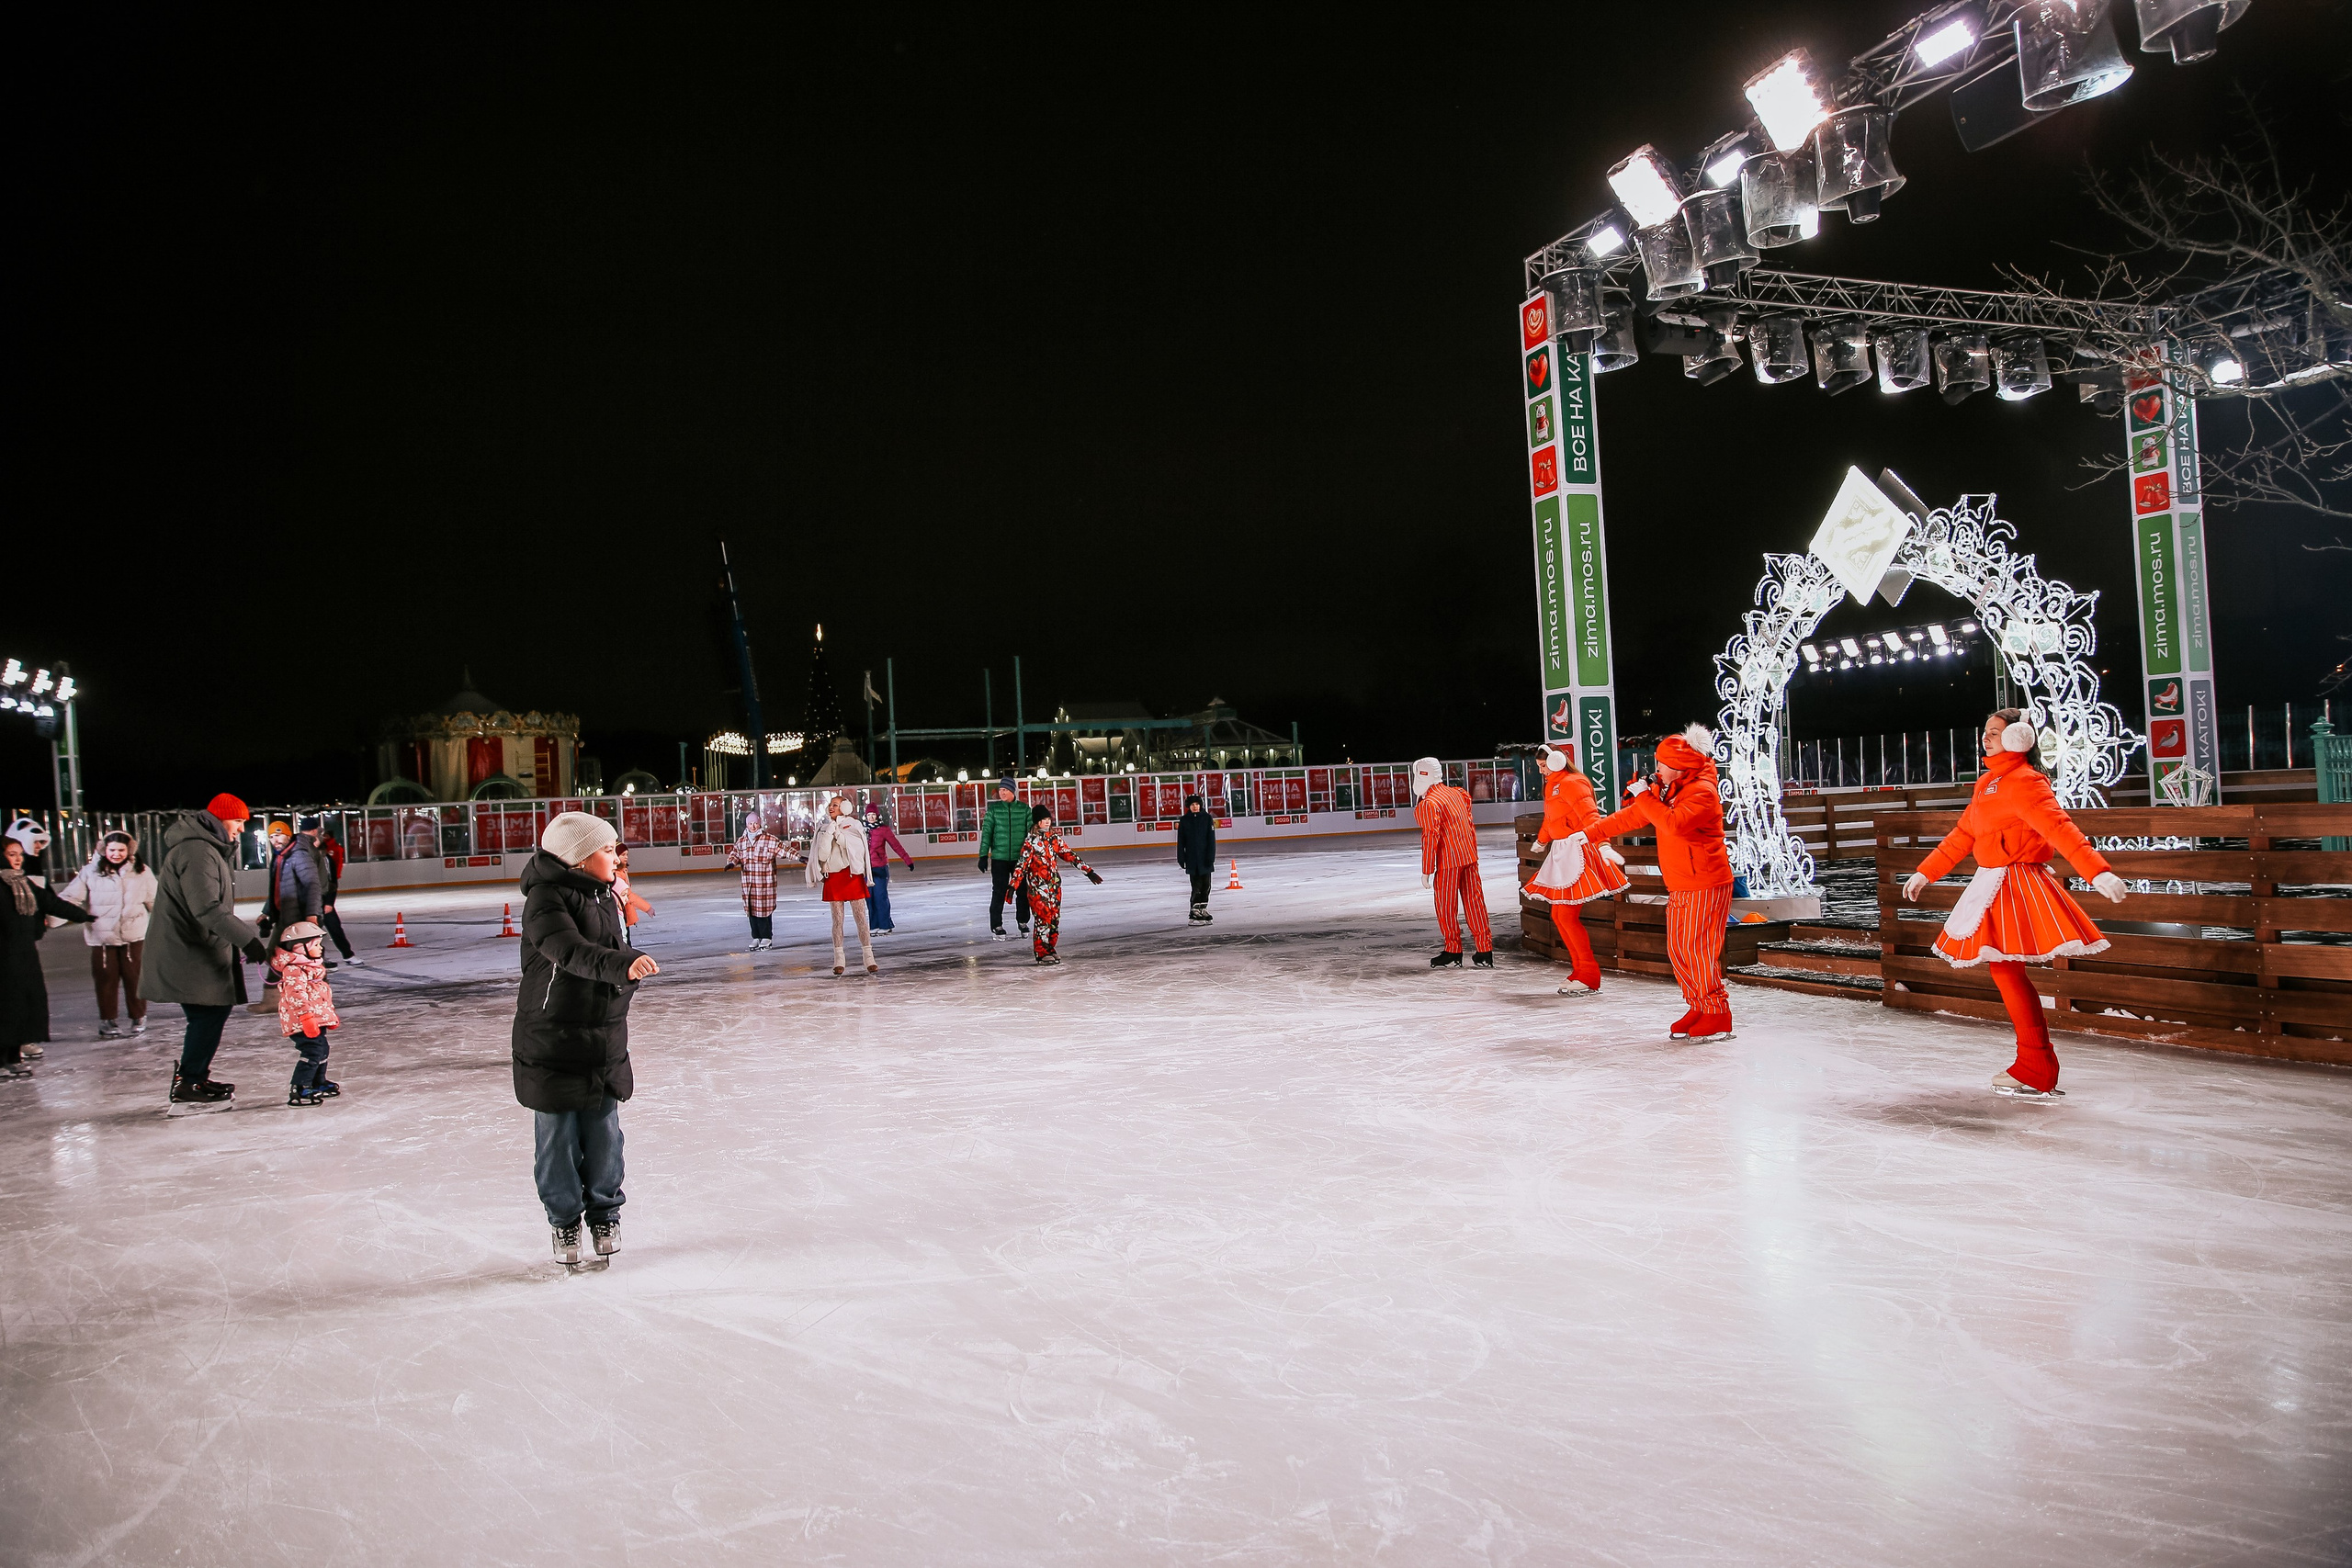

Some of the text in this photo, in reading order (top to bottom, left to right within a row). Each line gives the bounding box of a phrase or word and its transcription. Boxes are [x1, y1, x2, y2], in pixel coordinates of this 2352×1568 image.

[1568, 386, 1585, 420] НА
[2178, 423, 2189, 450] НА
[1572, 424, 1588, 472] ВСЕ
[2180, 455, 2193, 493] ВСЕ
[1544, 517, 1560, 671] zima.mos.ru
[1578, 522, 1599, 659] zima.mos.ru
[2150, 532, 2168, 659] zima.mos.ru
[2188, 536, 2203, 649] zima.mos.ru
[1589, 708, 1607, 792] КАТОК!
[2195, 690, 2211, 759] КАТОК!
[900, 799, 945, 811] ЗИМА
